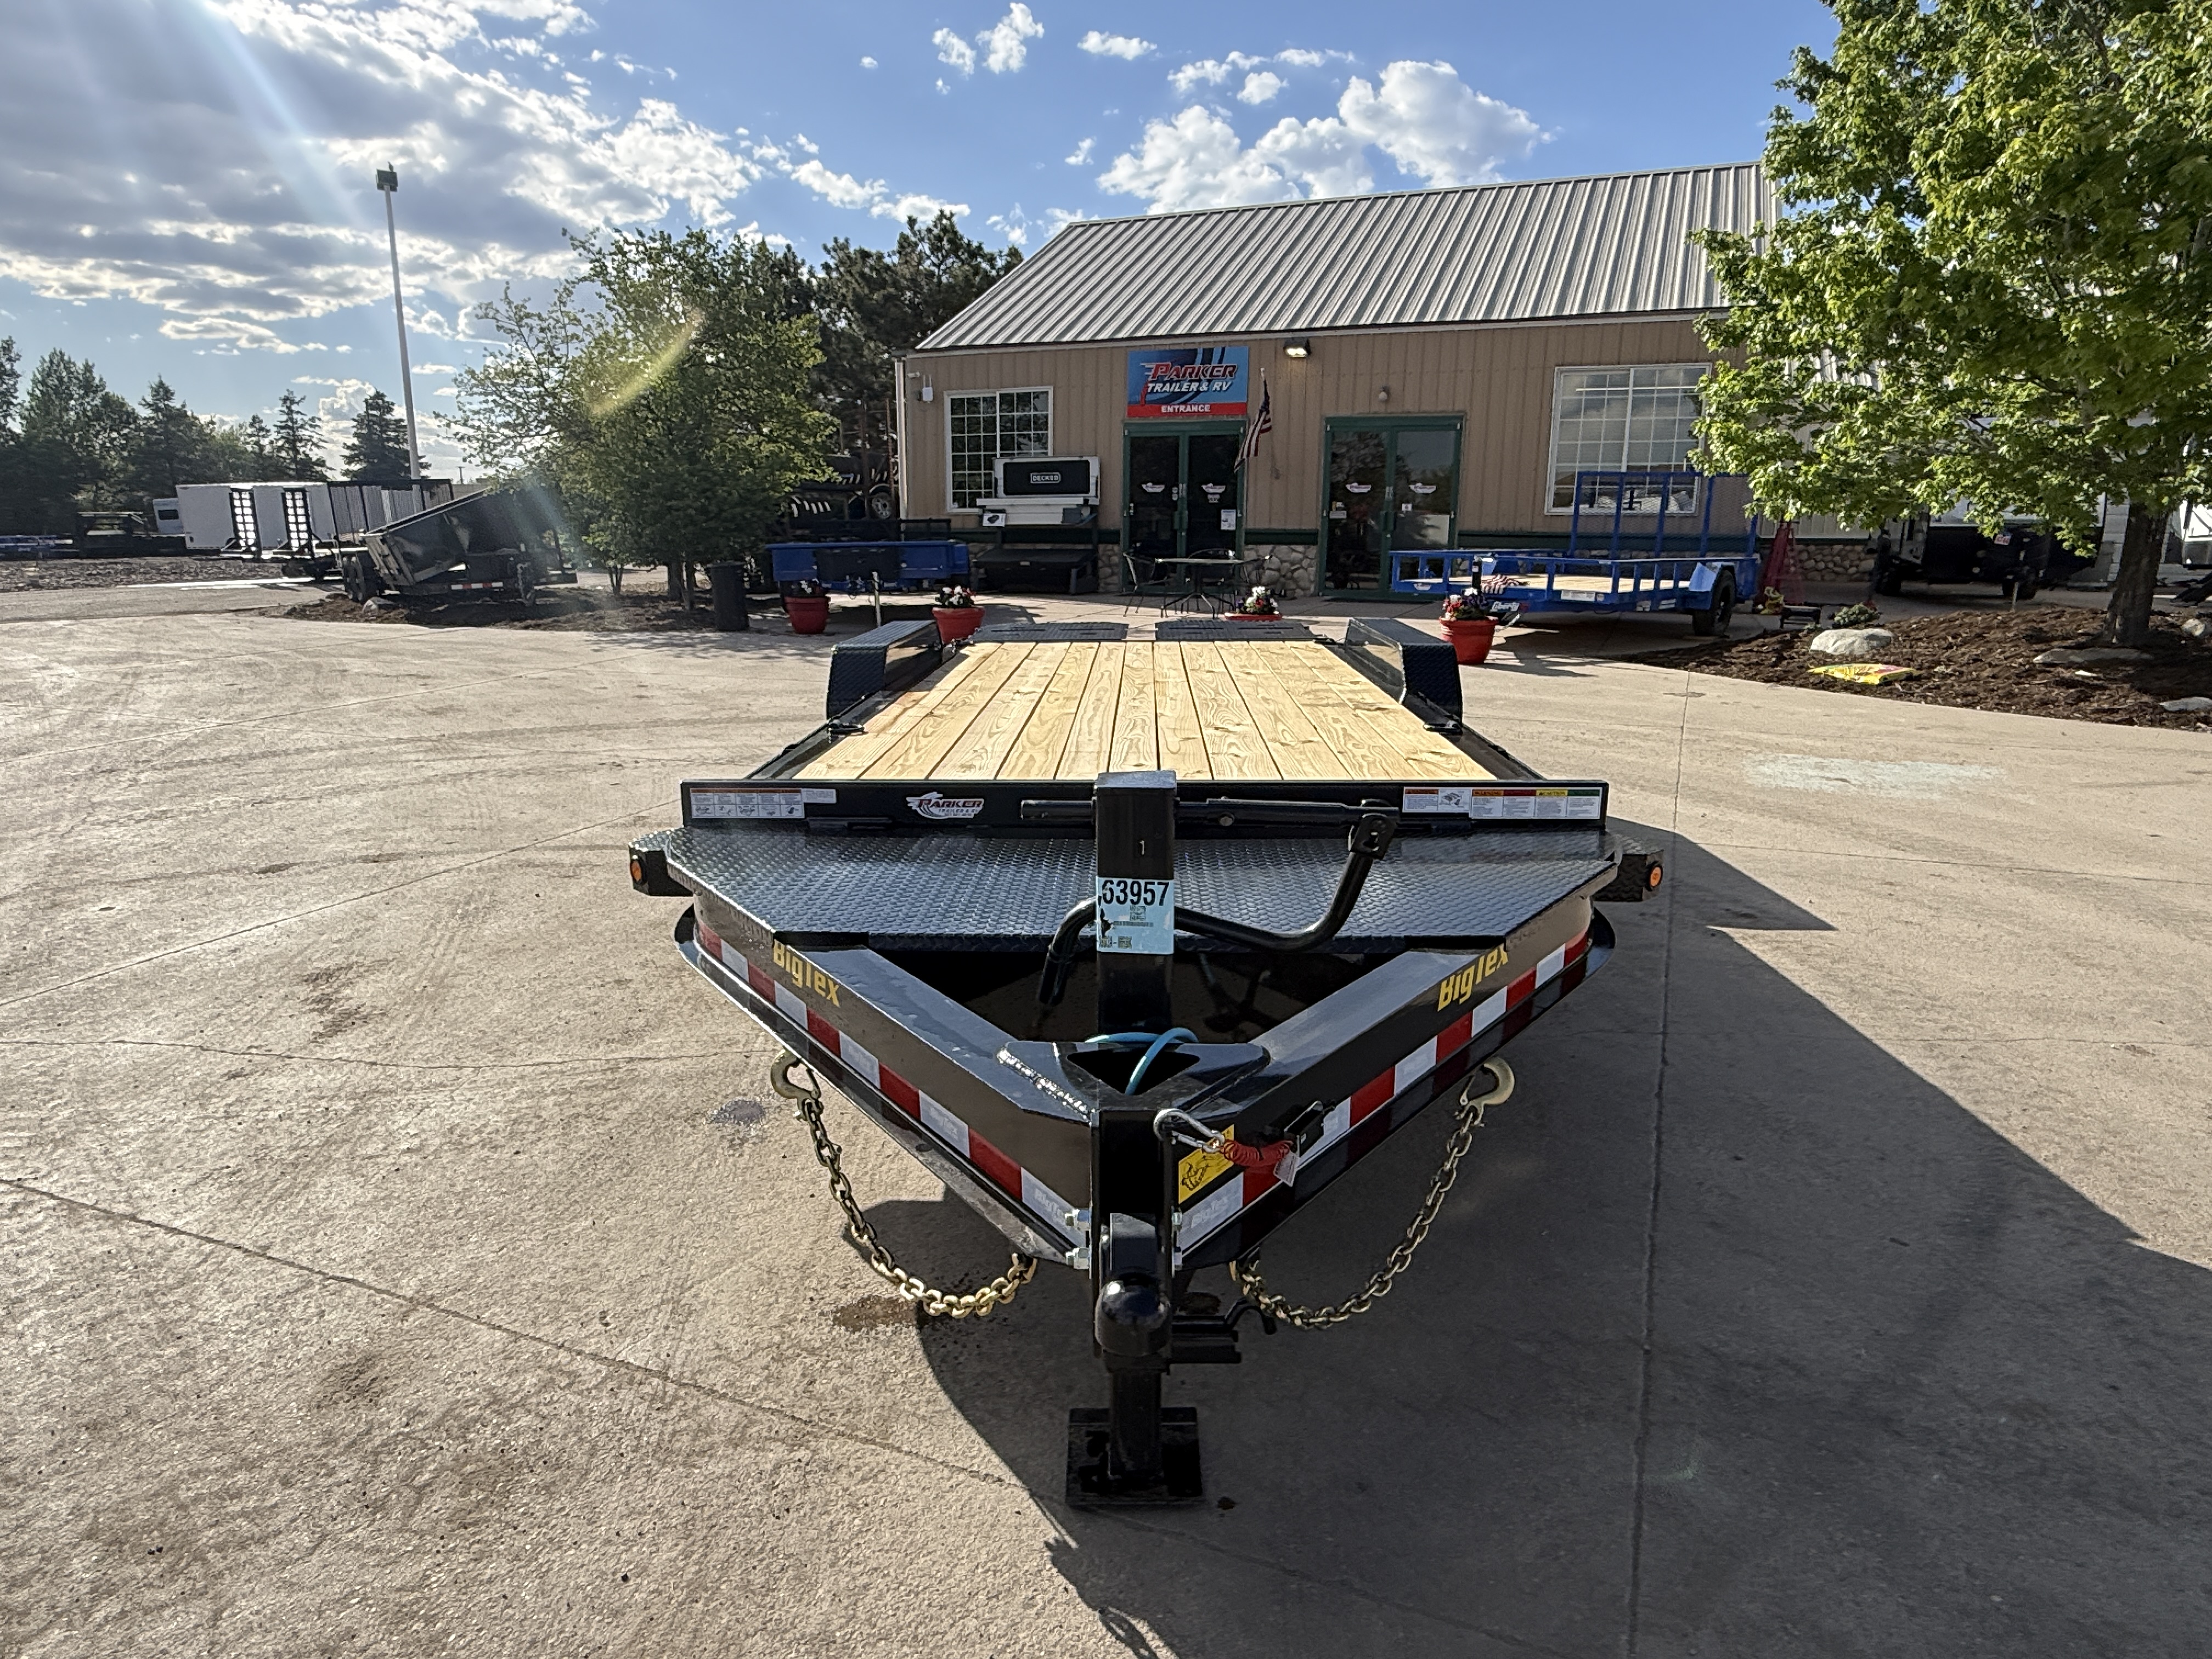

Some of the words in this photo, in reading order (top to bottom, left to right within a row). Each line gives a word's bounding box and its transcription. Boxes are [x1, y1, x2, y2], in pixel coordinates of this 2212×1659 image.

[1149, 362, 1238, 381] PARKER
[1147, 382, 1199, 393] TRAILER
[1199, 382, 1209, 391] &
[1212, 381, 1232, 392] RV
[1161, 404, 1211, 413] ENTRANCE
[917, 799, 983, 808] PARKER
[1102, 879, 1170, 906] 63957
